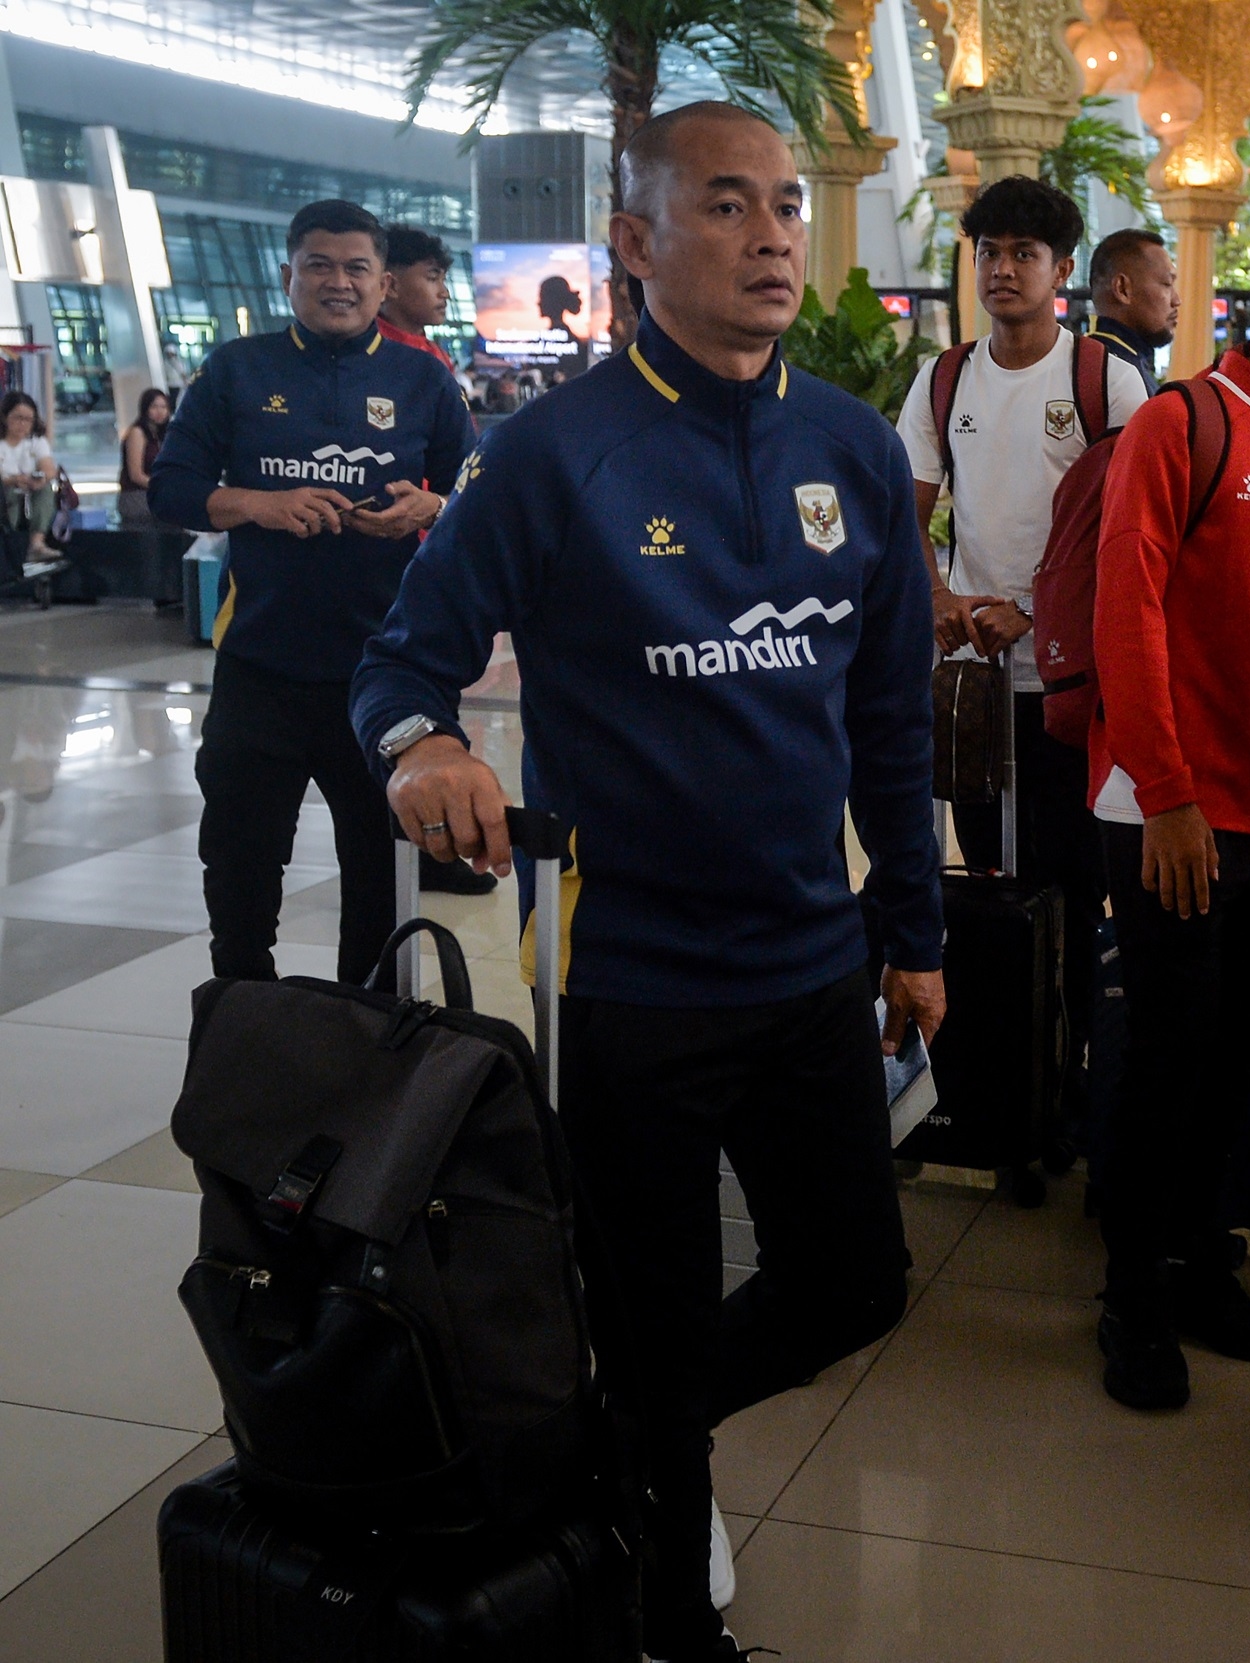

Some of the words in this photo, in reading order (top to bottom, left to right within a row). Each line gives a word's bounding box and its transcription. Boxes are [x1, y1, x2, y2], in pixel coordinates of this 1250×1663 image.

[259, 456, 366, 486] mandiri
[639, 544, 686, 556] KELME
[644, 626, 818, 678] mandiri
[320, 1584, 356, 1606] KDY
